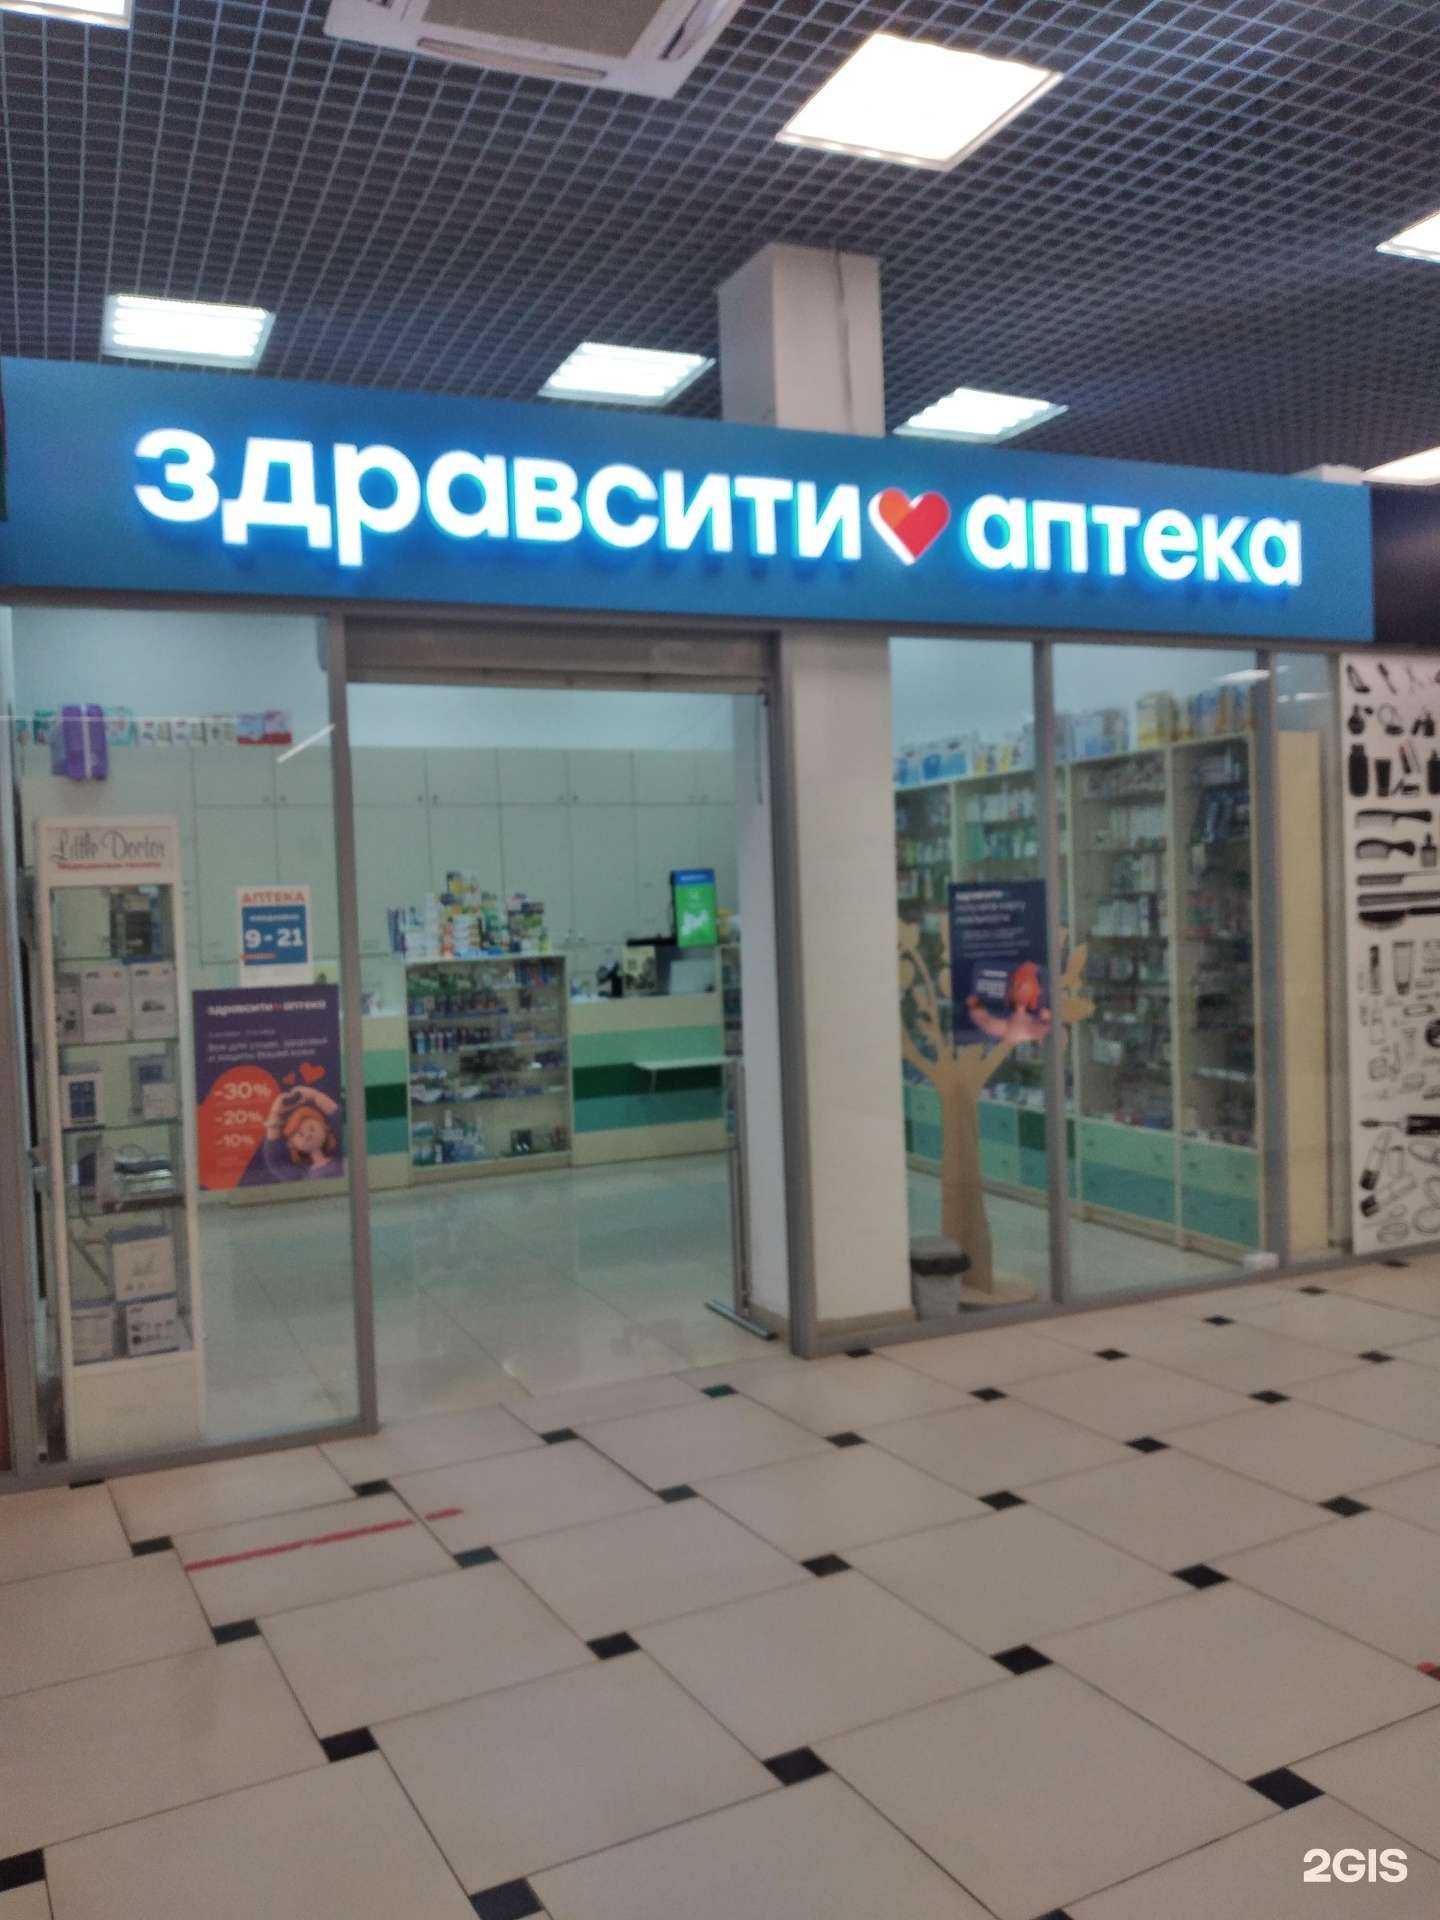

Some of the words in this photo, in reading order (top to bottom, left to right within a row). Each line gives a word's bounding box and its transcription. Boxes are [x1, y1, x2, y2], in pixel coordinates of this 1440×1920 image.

[135, 428, 862, 567] здравсити
[964, 493, 1302, 587] аптека
[242, 890, 305, 904] АПТЕКА
